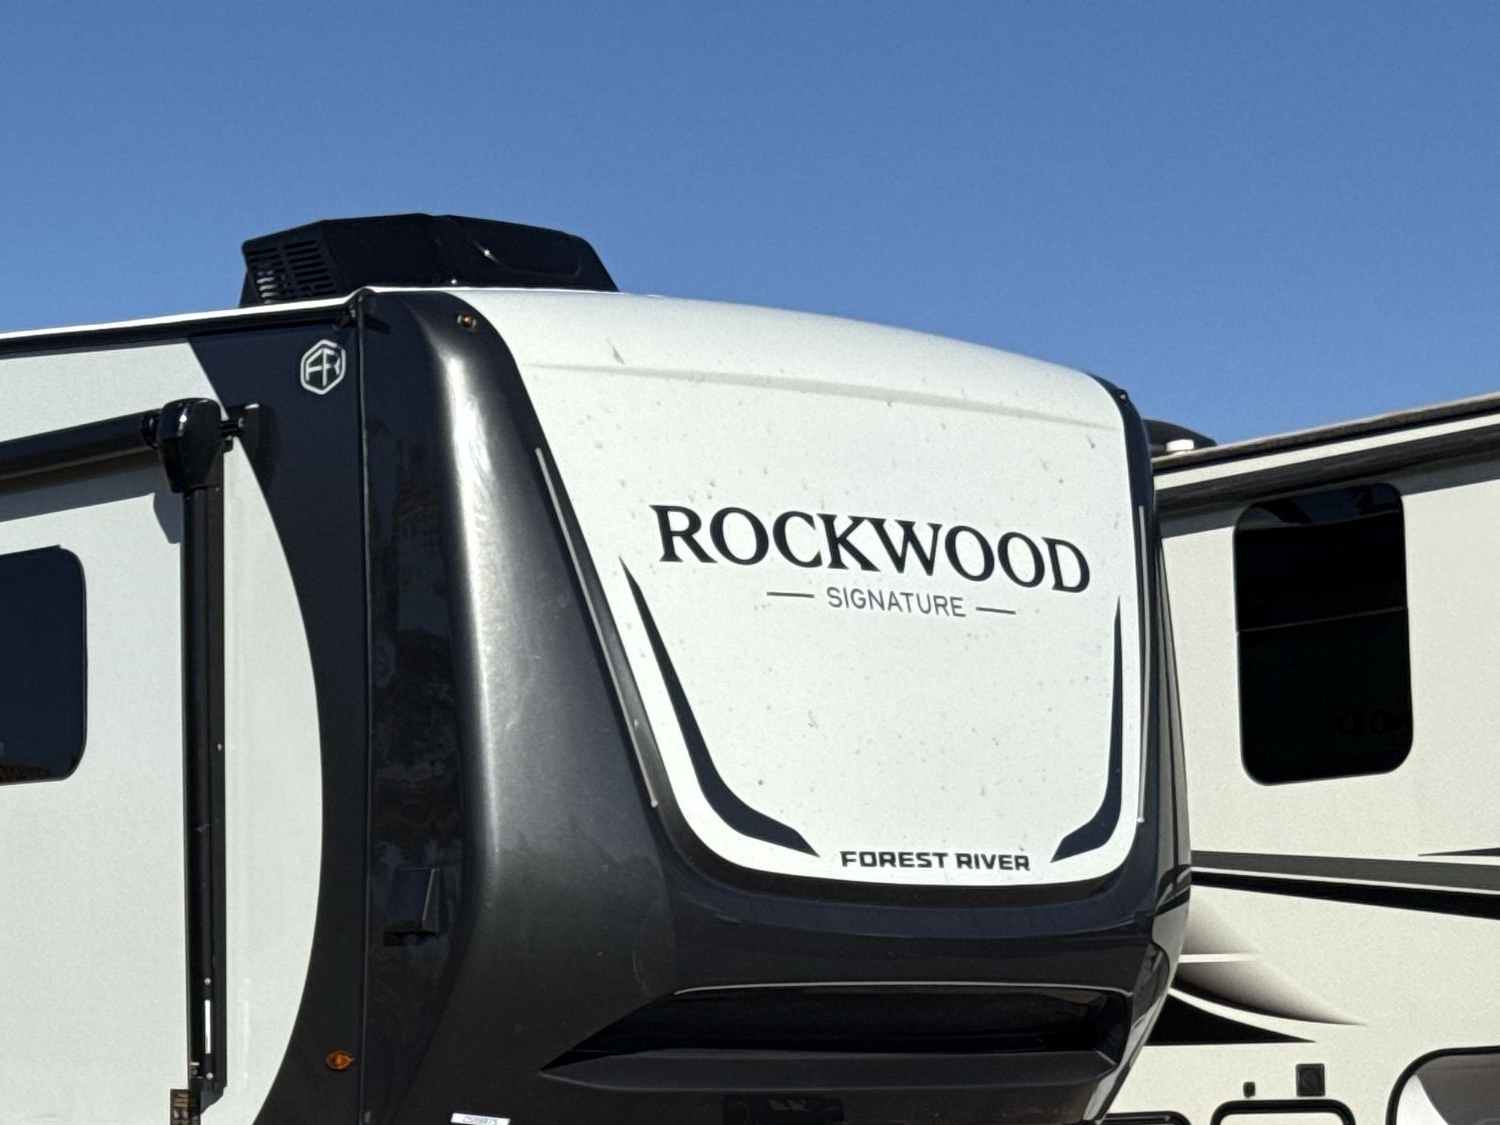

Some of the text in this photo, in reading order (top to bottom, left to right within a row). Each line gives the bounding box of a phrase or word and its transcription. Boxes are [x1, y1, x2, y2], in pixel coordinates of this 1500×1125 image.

[649, 504, 1090, 594] ROCKWOOD
[826, 586, 967, 617] SIGNATURE
[839, 850, 1031, 872] FOREST RIVER
